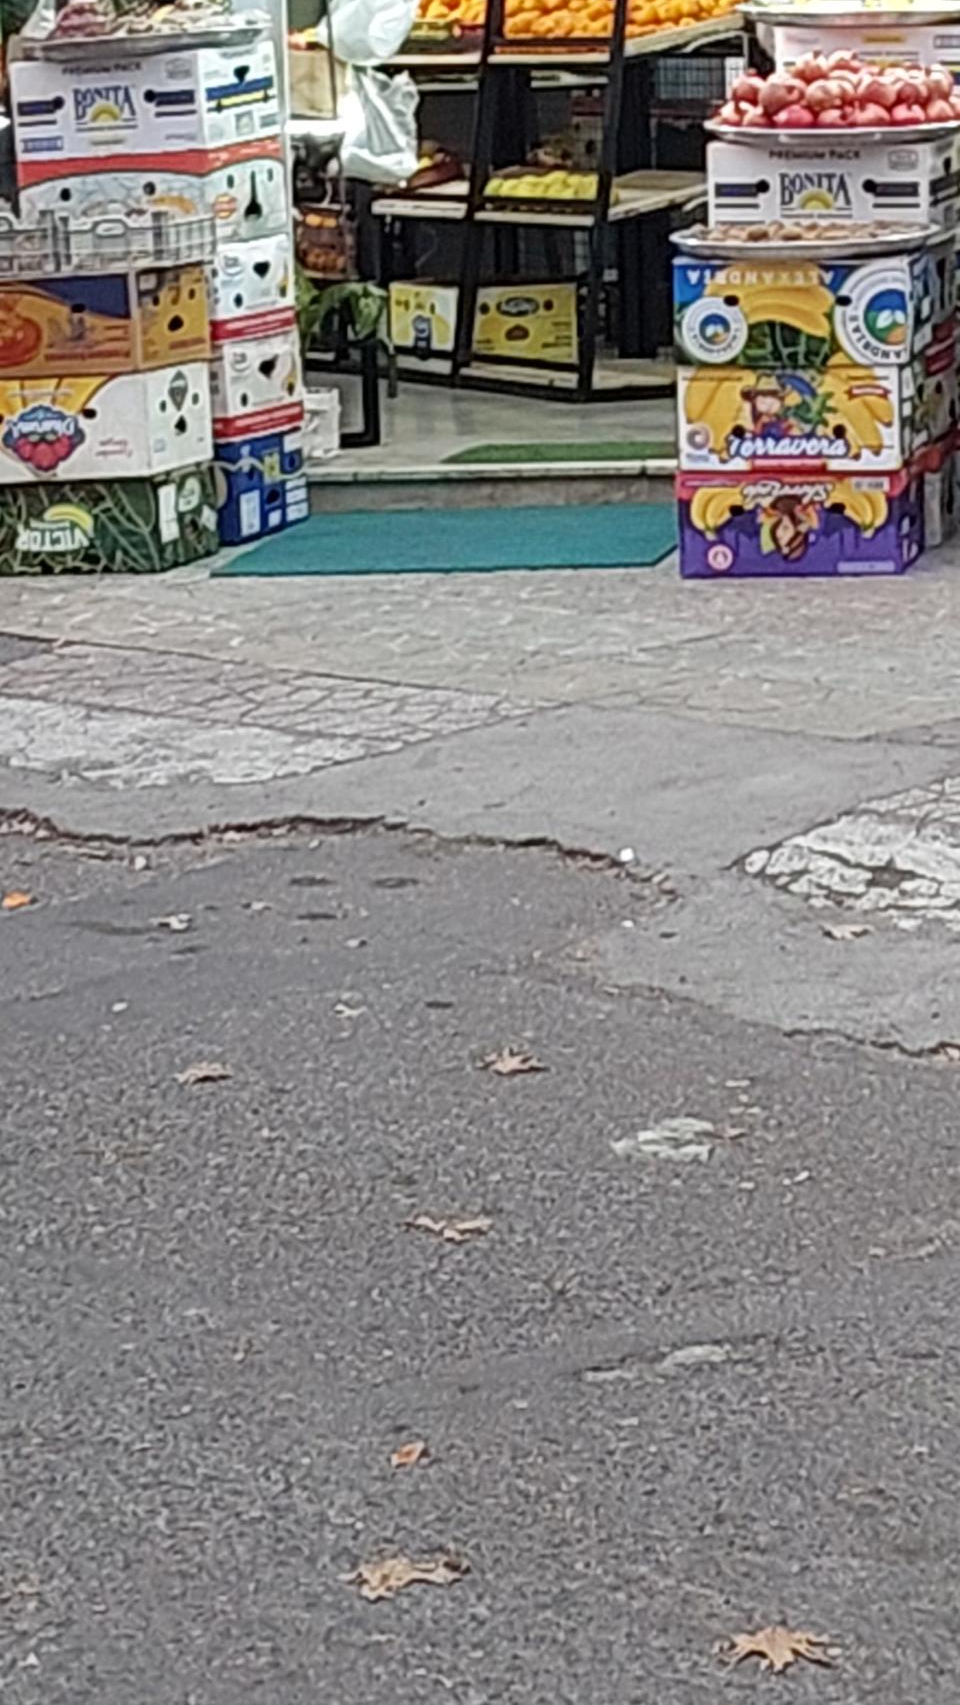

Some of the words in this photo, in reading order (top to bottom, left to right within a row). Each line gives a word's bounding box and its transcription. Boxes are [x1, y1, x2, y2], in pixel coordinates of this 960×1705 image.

[72, 85, 137, 121] BONITA
[779, 172, 853, 206] BONITA
[687, 269, 835, 285] ALEXANDRIA
[15, 523, 91, 553] VICTOR
